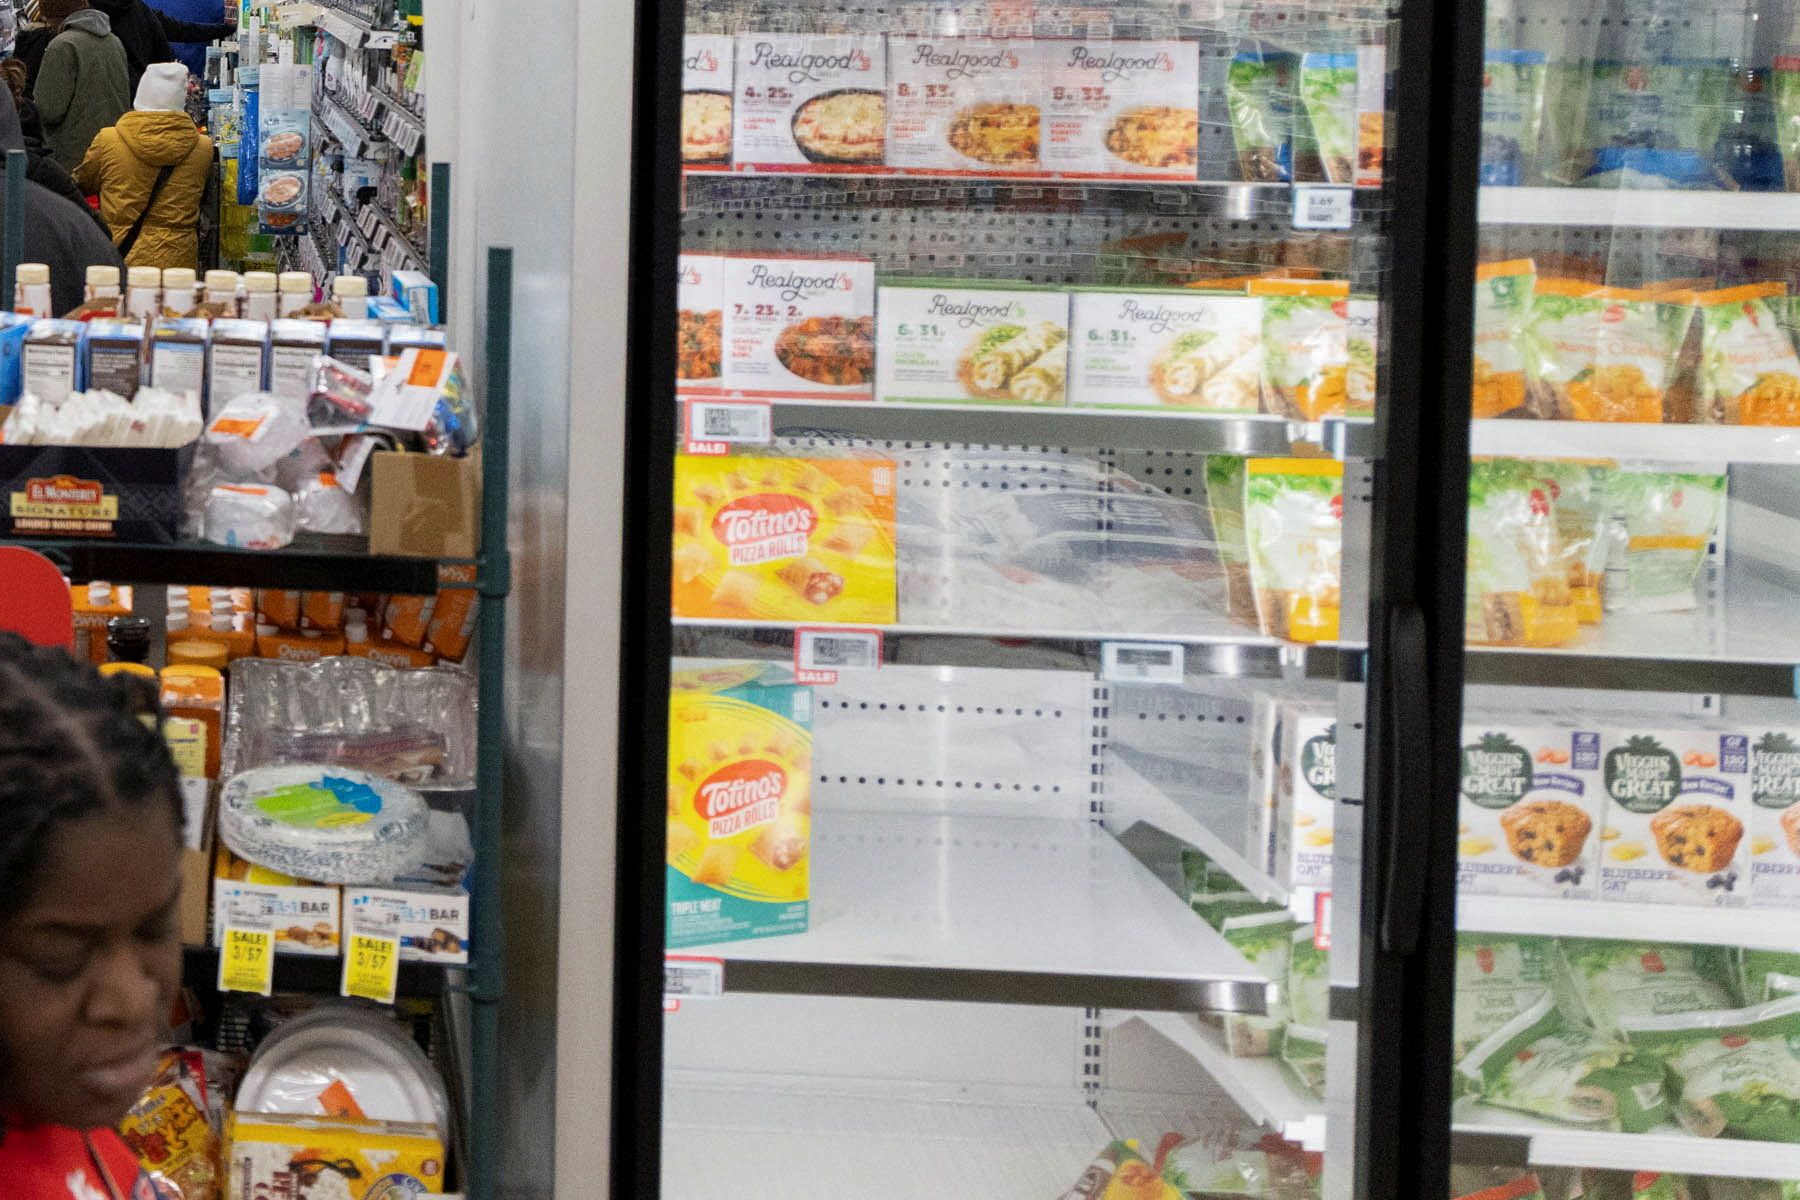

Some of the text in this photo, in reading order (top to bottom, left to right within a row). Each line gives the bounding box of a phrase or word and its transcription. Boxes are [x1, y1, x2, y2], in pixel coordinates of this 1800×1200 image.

[751, 43, 856, 84] Realgood
[912, 45, 1006, 78] Realgood
[1067, 46, 1159, 81] Realgood
[748, 265, 836, 301] Realgood
[689, 443, 725, 453] SALE!
[720, 508, 811, 542] Totino's
[733, 545, 765, 562] PIZZA
[702, 772, 781, 816] Totino's
[1612, 779, 1674, 798] GREAT
[712, 802, 775, 835] PIZZA ROLLS
[301, 901, 329, 913] BAR
[430, 910, 459, 920] BAR
[232, 932, 267, 944] SALE!
[357, 938, 392, 950] SALE!
